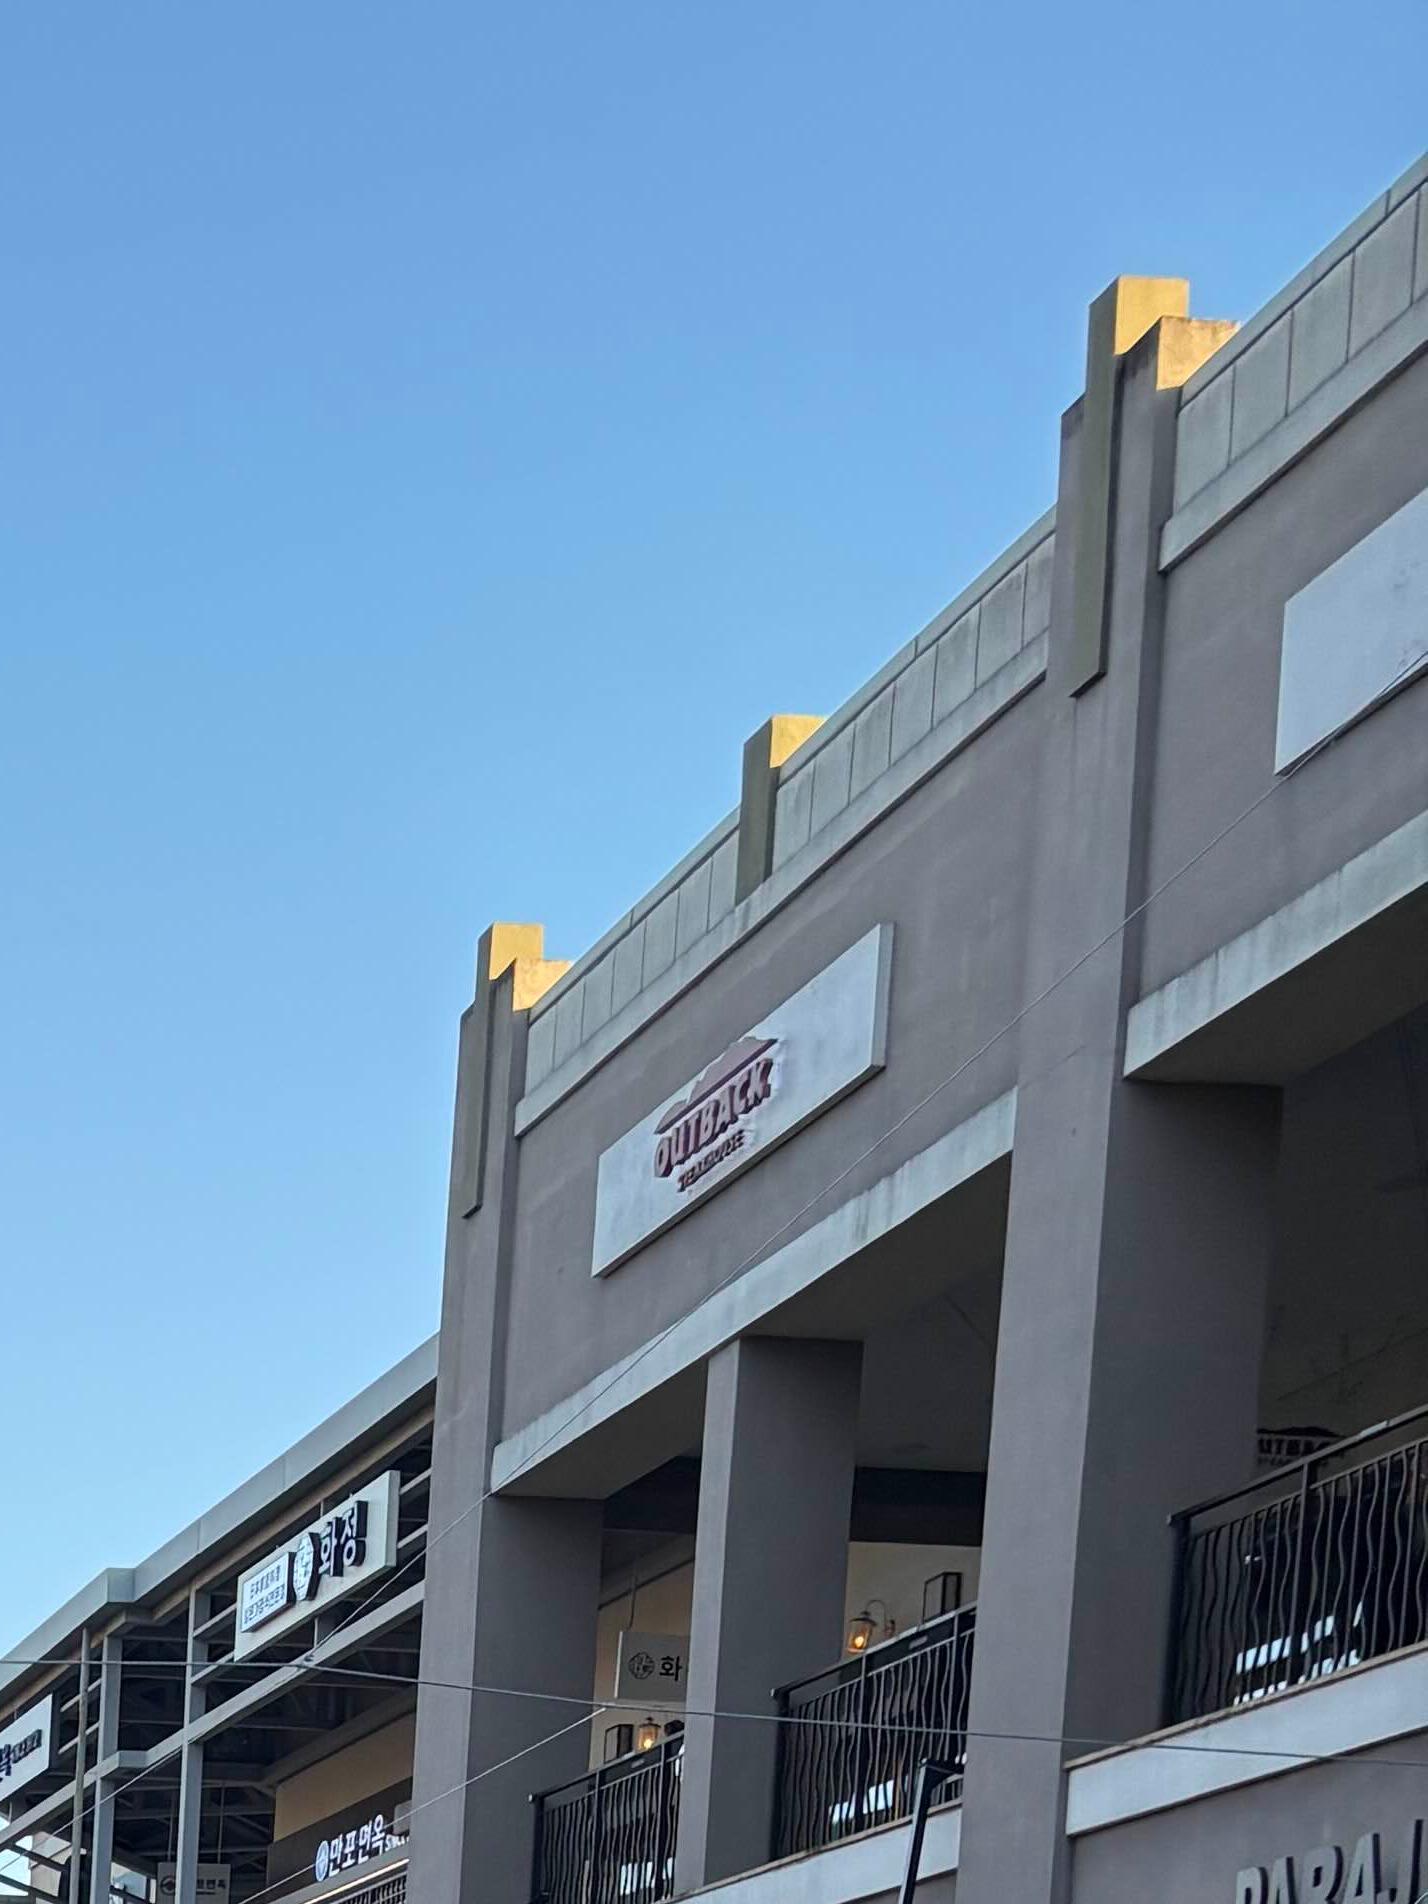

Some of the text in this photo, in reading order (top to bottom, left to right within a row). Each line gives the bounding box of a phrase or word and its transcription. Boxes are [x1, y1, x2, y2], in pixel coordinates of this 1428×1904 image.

[654, 1059, 774, 1177] OUTBACK
[319, 1500, 368, 1577] 화정
[659, 1656, 683, 1682] 화
[328, 1814, 385, 1878] 만포면옥
